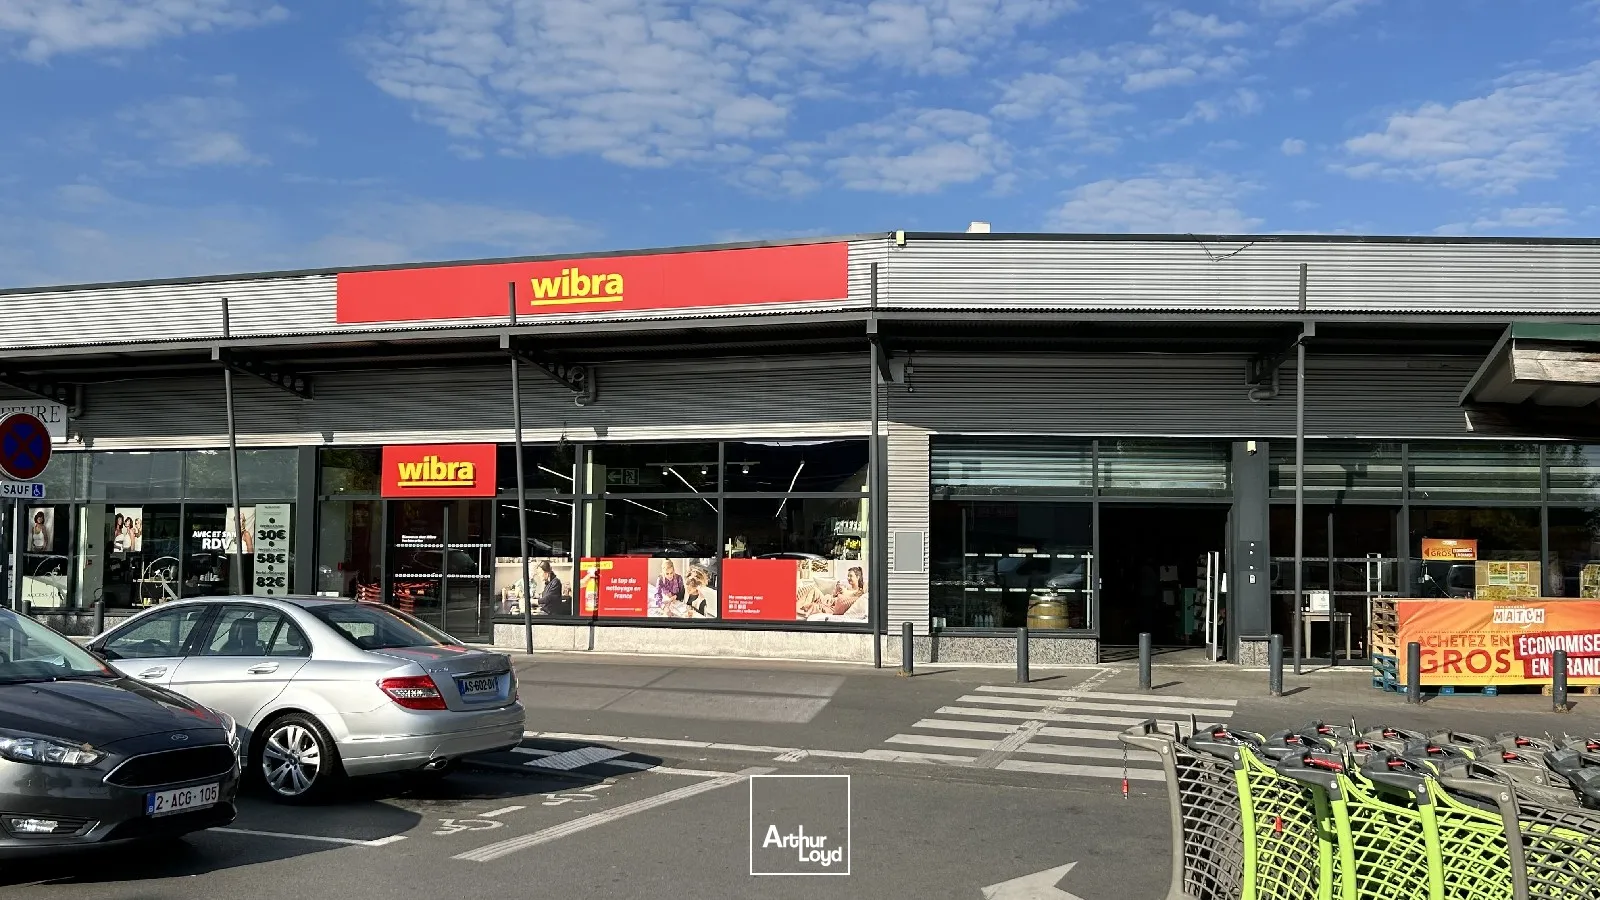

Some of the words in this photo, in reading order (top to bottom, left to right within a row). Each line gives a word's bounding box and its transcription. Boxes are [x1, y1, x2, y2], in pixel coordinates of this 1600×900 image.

[531, 267, 623, 299] wibra
[397, 455, 474, 480] wibra
[3, 484, 30, 495] SAUF
[257, 530, 287, 541] 30€
[202, 538, 230, 550] RDV
[256, 553, 286, 563] 58€
[256, 576, 286, 588] 82€
[1494, 609, 1544, 622] MATCH
[1417, 634, 1486, 648] ACHETEZ
[1491, 634, 1511, 648] EN
[1419, 648, 1511, 674] GROS
[1531, 657, 1550, 676] EN
[1566, 657, 1600, 676] RAND
